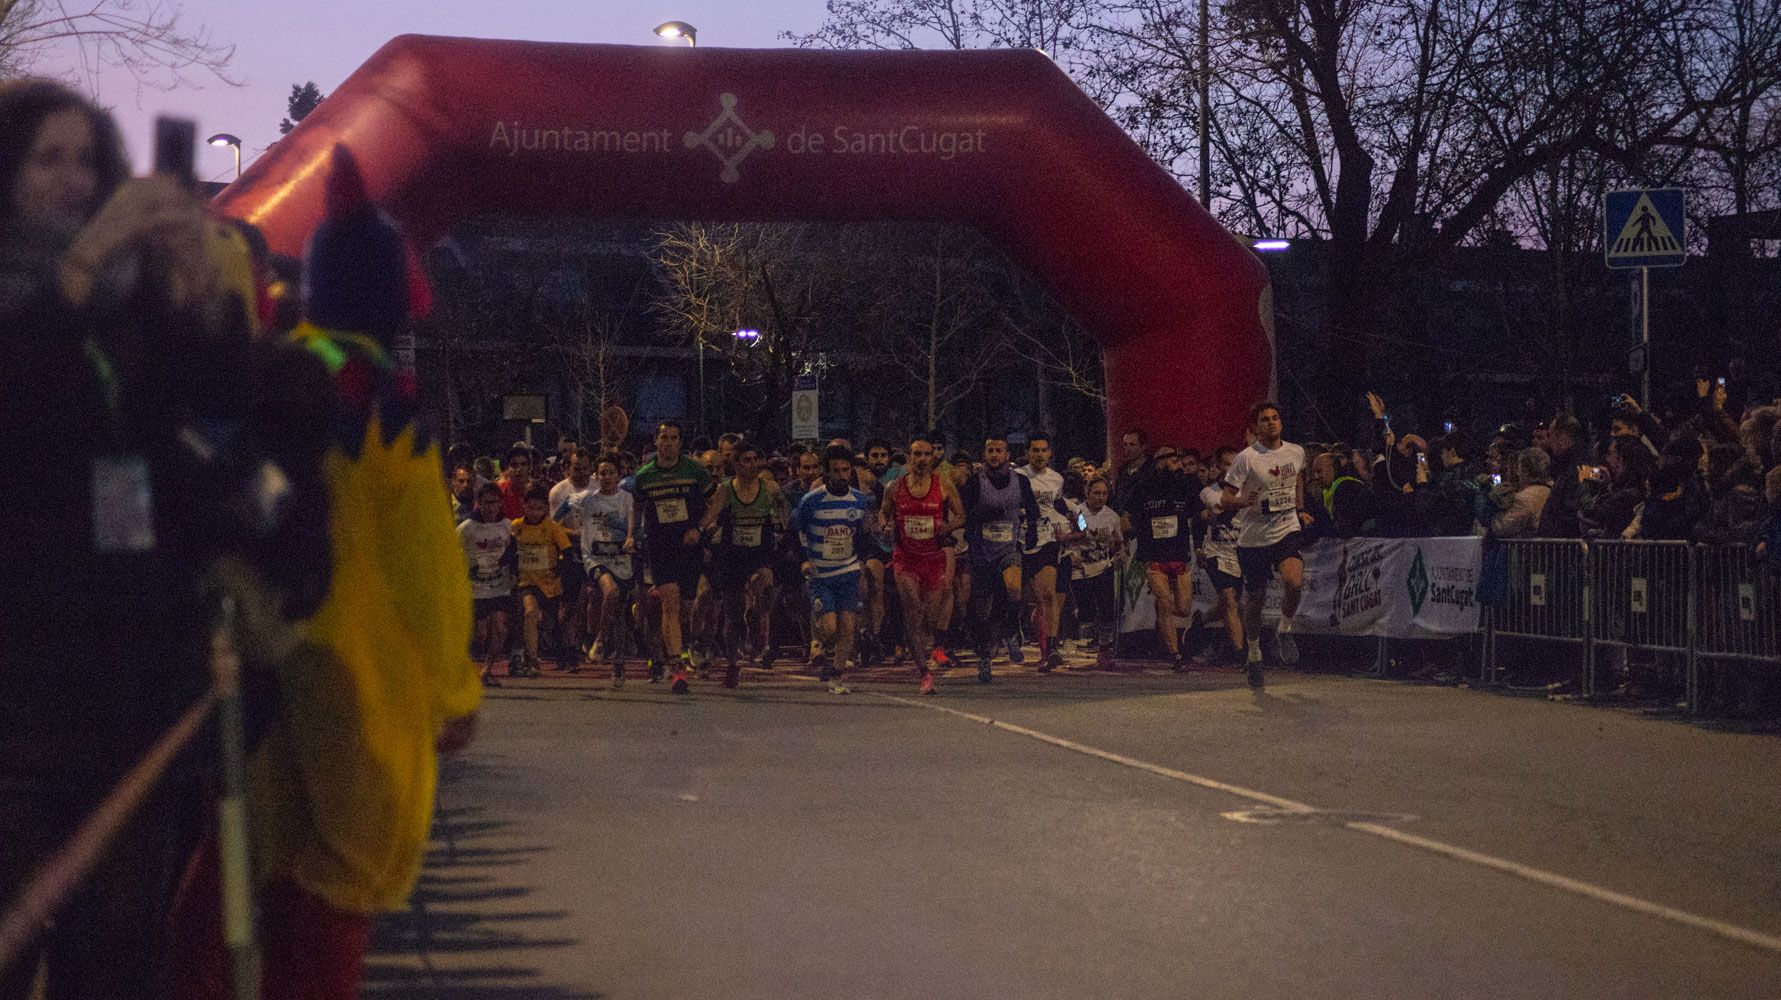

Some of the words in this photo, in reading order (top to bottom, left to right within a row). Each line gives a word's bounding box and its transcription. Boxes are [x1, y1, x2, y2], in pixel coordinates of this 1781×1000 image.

[488, 119, 672, 156] Ajuntament
[786, 123, 825, 154] de
[832, 125, 987, 160] SantCugat
[1343, 569, 1371, 600] GALL
[1430, 582, 1474, 612] SantCugat
